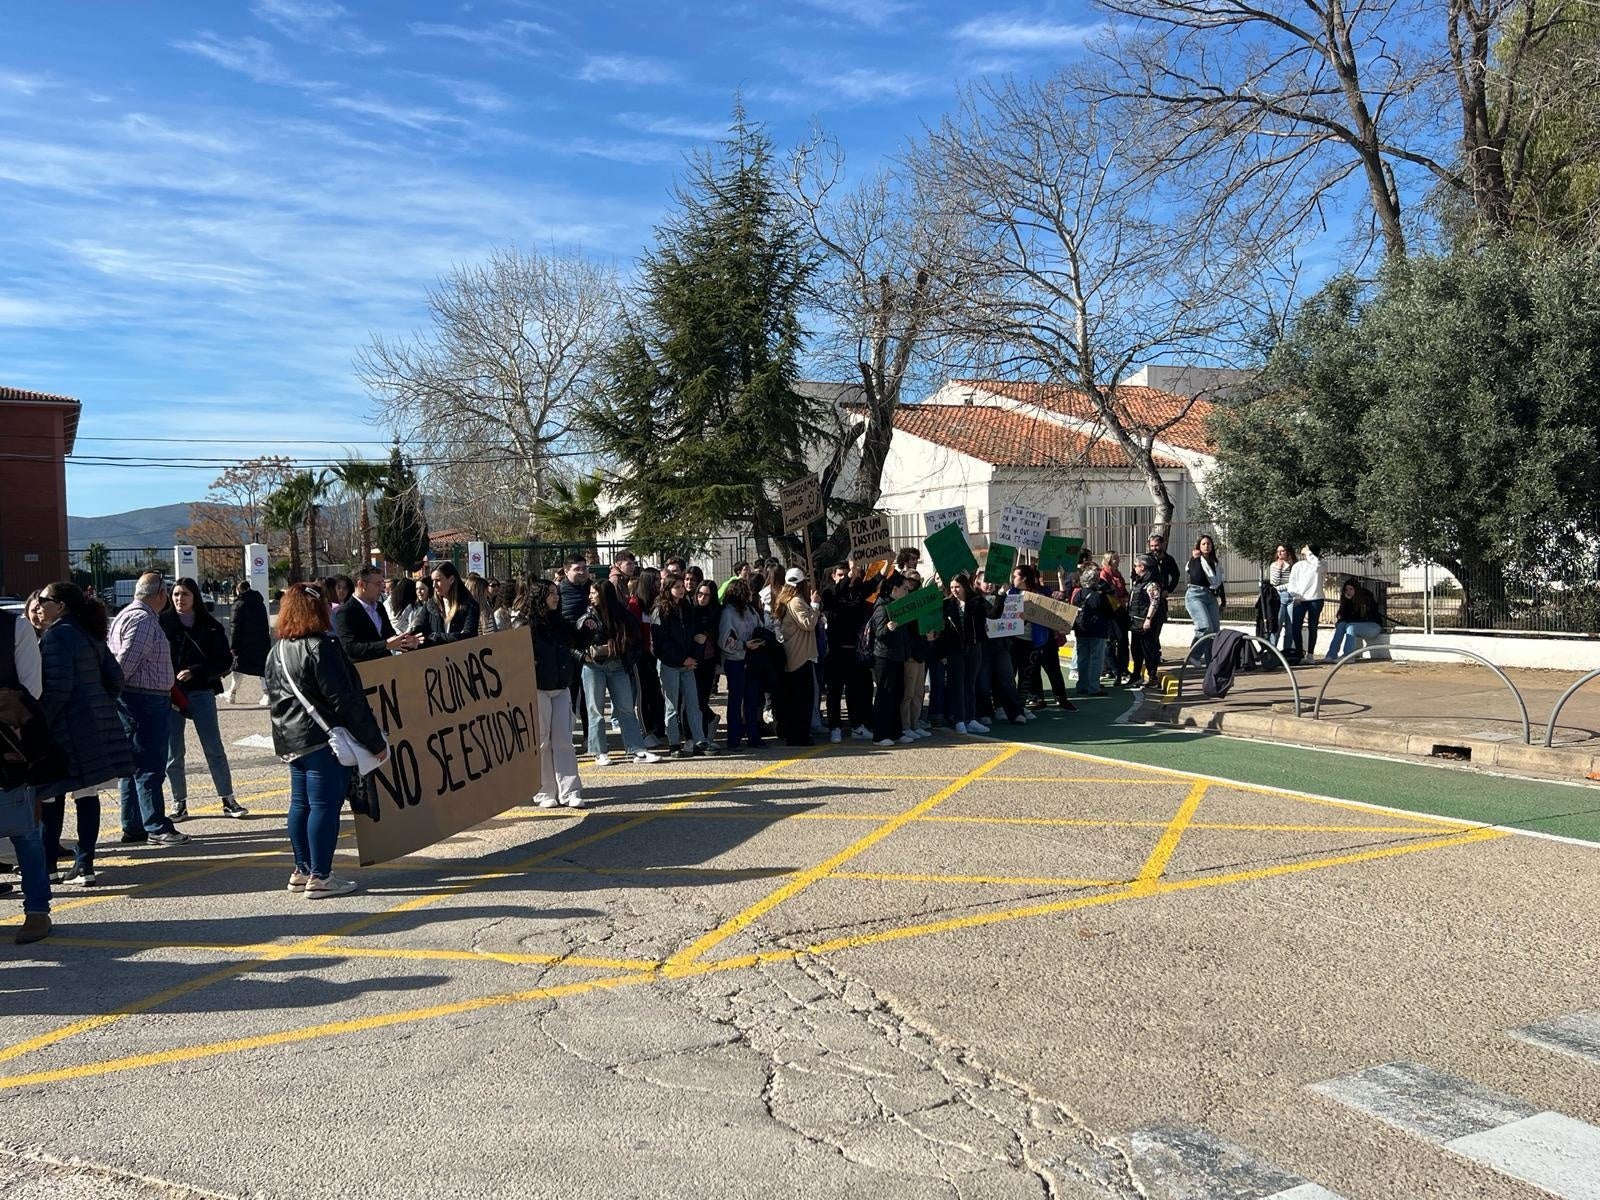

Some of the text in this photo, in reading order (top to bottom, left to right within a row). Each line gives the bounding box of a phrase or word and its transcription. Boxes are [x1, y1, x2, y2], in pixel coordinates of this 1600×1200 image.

[851, 517, 881, 534] POR UN
[852, 528, 889, 547] INSTITUTO
[853, 548, 866, 561] CON
[373, 739, 422, 810] NO
